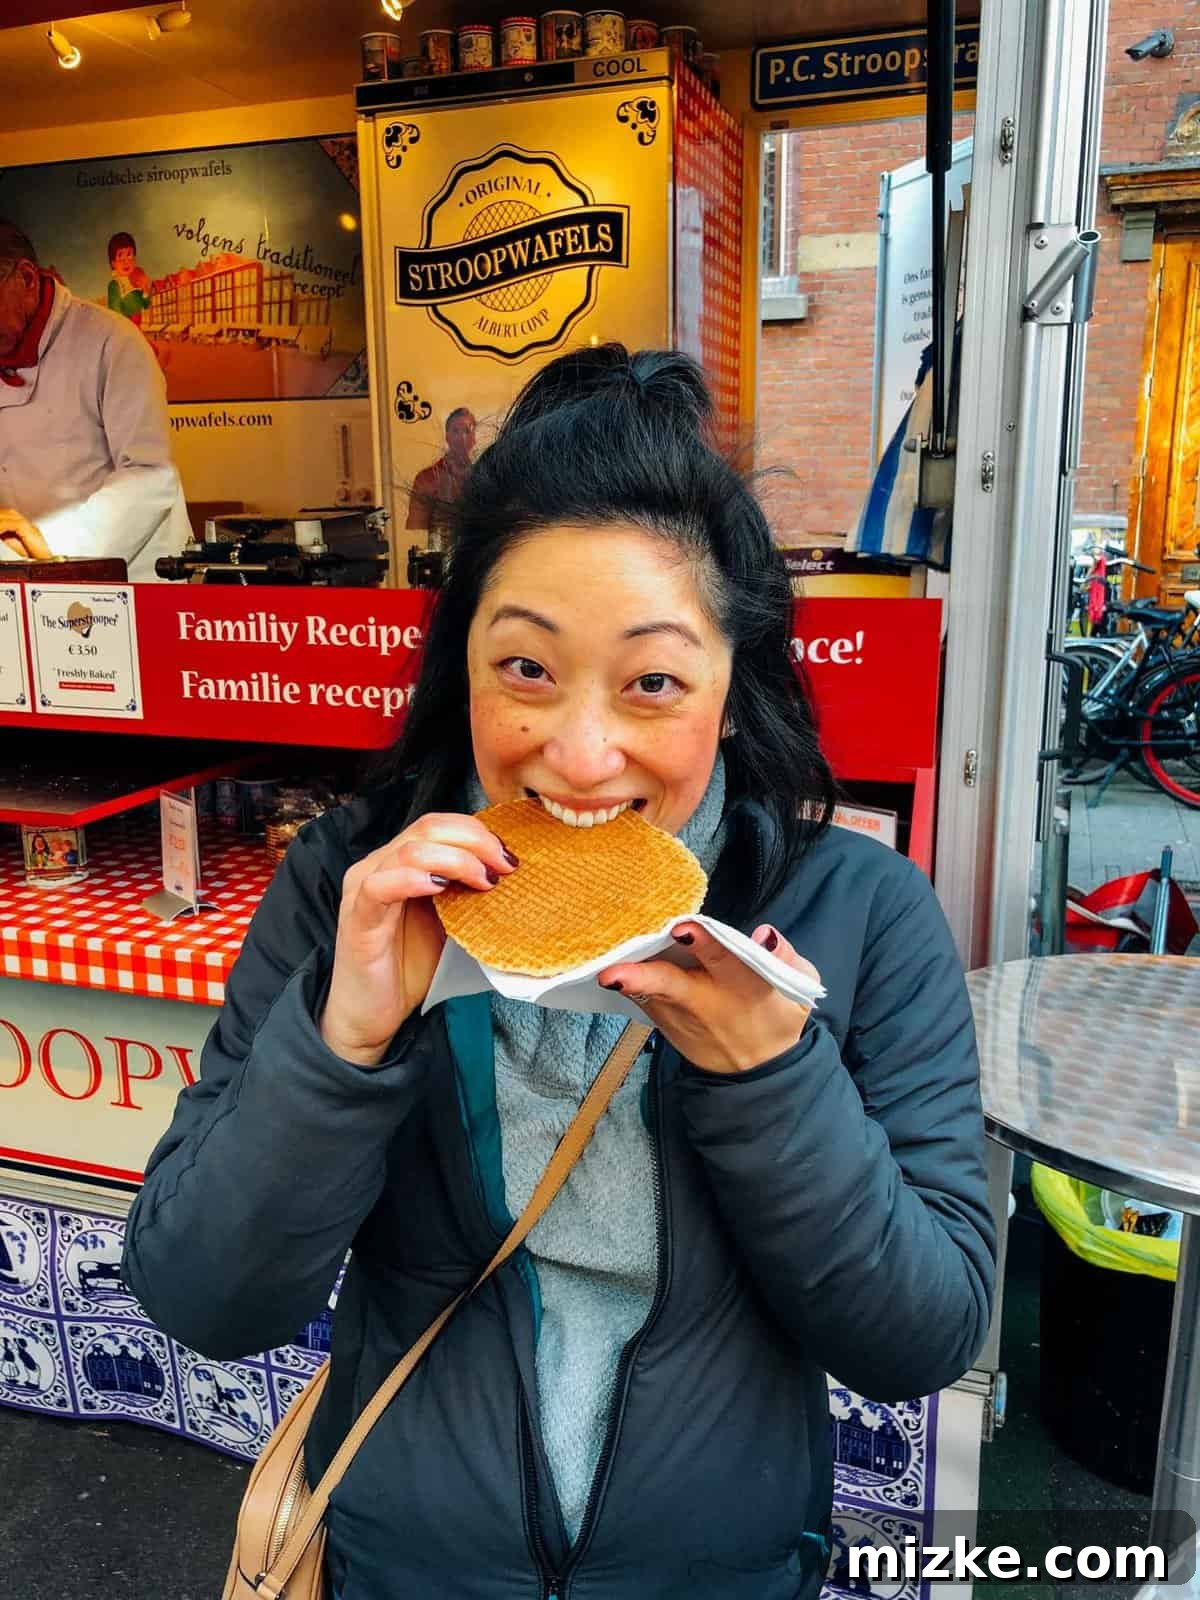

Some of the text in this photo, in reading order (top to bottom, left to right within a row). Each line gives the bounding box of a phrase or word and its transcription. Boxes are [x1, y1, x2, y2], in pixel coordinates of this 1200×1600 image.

[592, 57, 648, 78] COOL
[768, 55, 816, 85] P.C.
[465, 175, 542, 204] ORIGINAL
[173, 217, 358, 287] volgens traditioneel
[408, 223, 614, 292] STROOPWAFELS
[292, 278, 344, 299] recept
[473, 308, 551, 338] ALBERT CUYP
[41, 615, 57, 628] The
[177, 611, 423, 656] Familiy Recipe
[180, 670, 417, 718] Familie recept
